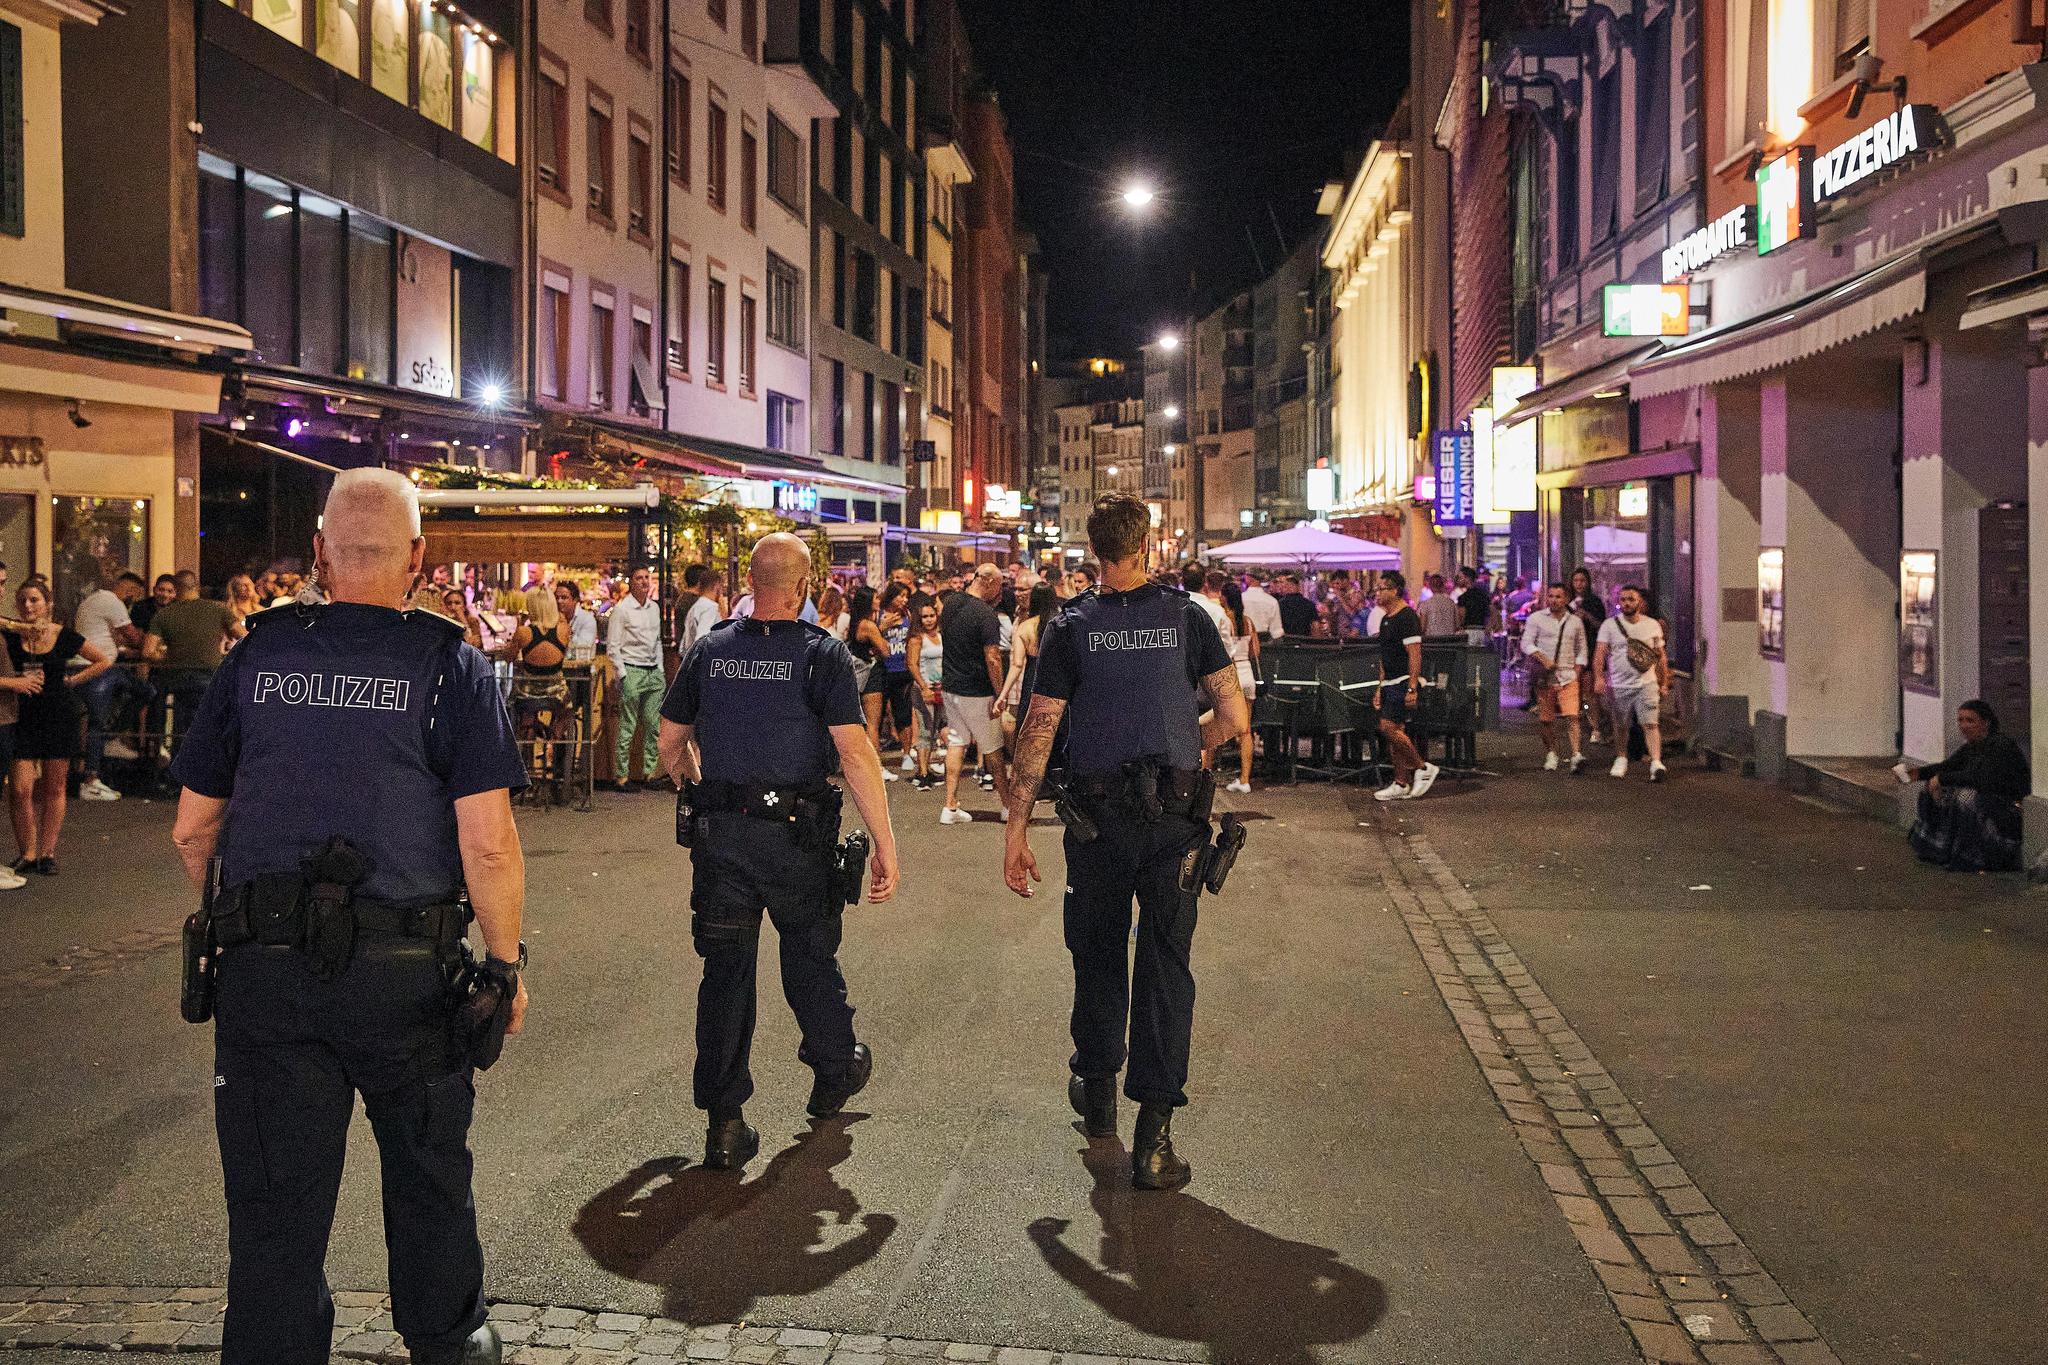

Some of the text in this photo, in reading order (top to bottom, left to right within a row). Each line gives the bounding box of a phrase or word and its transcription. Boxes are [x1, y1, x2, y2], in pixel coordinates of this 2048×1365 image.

[1813, 104, 1918, 203] PIZZERIA
[1440, 436, 1455, 519] KIESER
[1460, 436, 1474, 519] TRAINING
[709, 658, 793, 680] POLIZEI
[1089, 628, 1178, 652] POLIZEI
[254, 672, 410, 711] POLIZEI
